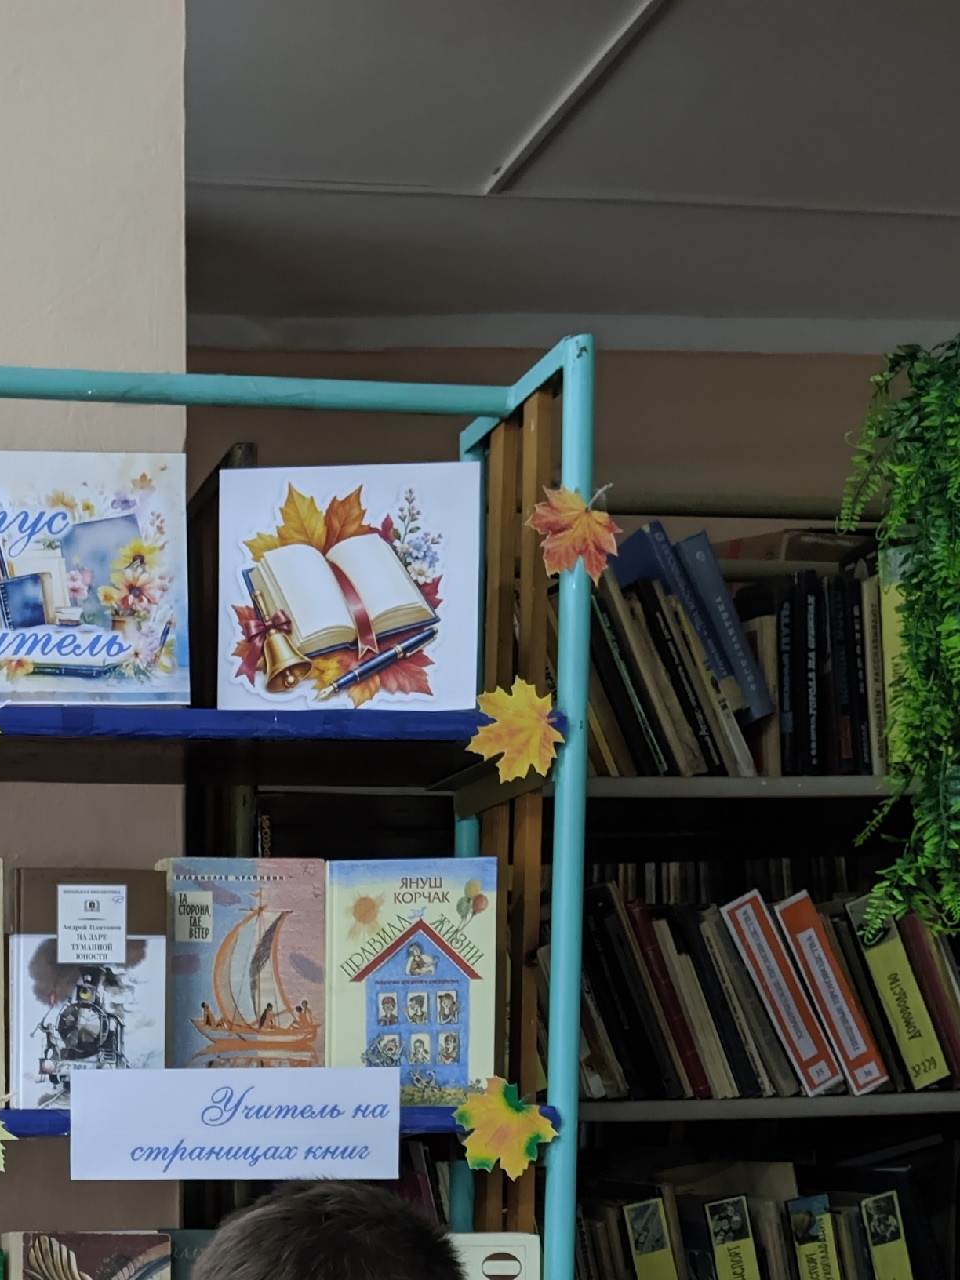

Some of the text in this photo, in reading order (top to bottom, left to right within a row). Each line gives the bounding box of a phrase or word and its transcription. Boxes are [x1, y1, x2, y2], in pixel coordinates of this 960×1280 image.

[179, 893, 188, 904] ТА
[393, 891, 451, 904] КОРЧАК
[399, 877, 443, 889] ЯНУШ
[340, 913, 485, 978] ПРАВИЛА ЖИЗНИ
[888, 973, 922, 1040] ДОМОВОДСТВО
[201, 1086, 389, 1127] Учитель на
[130, 1139, 370, 1174] страницах книг
